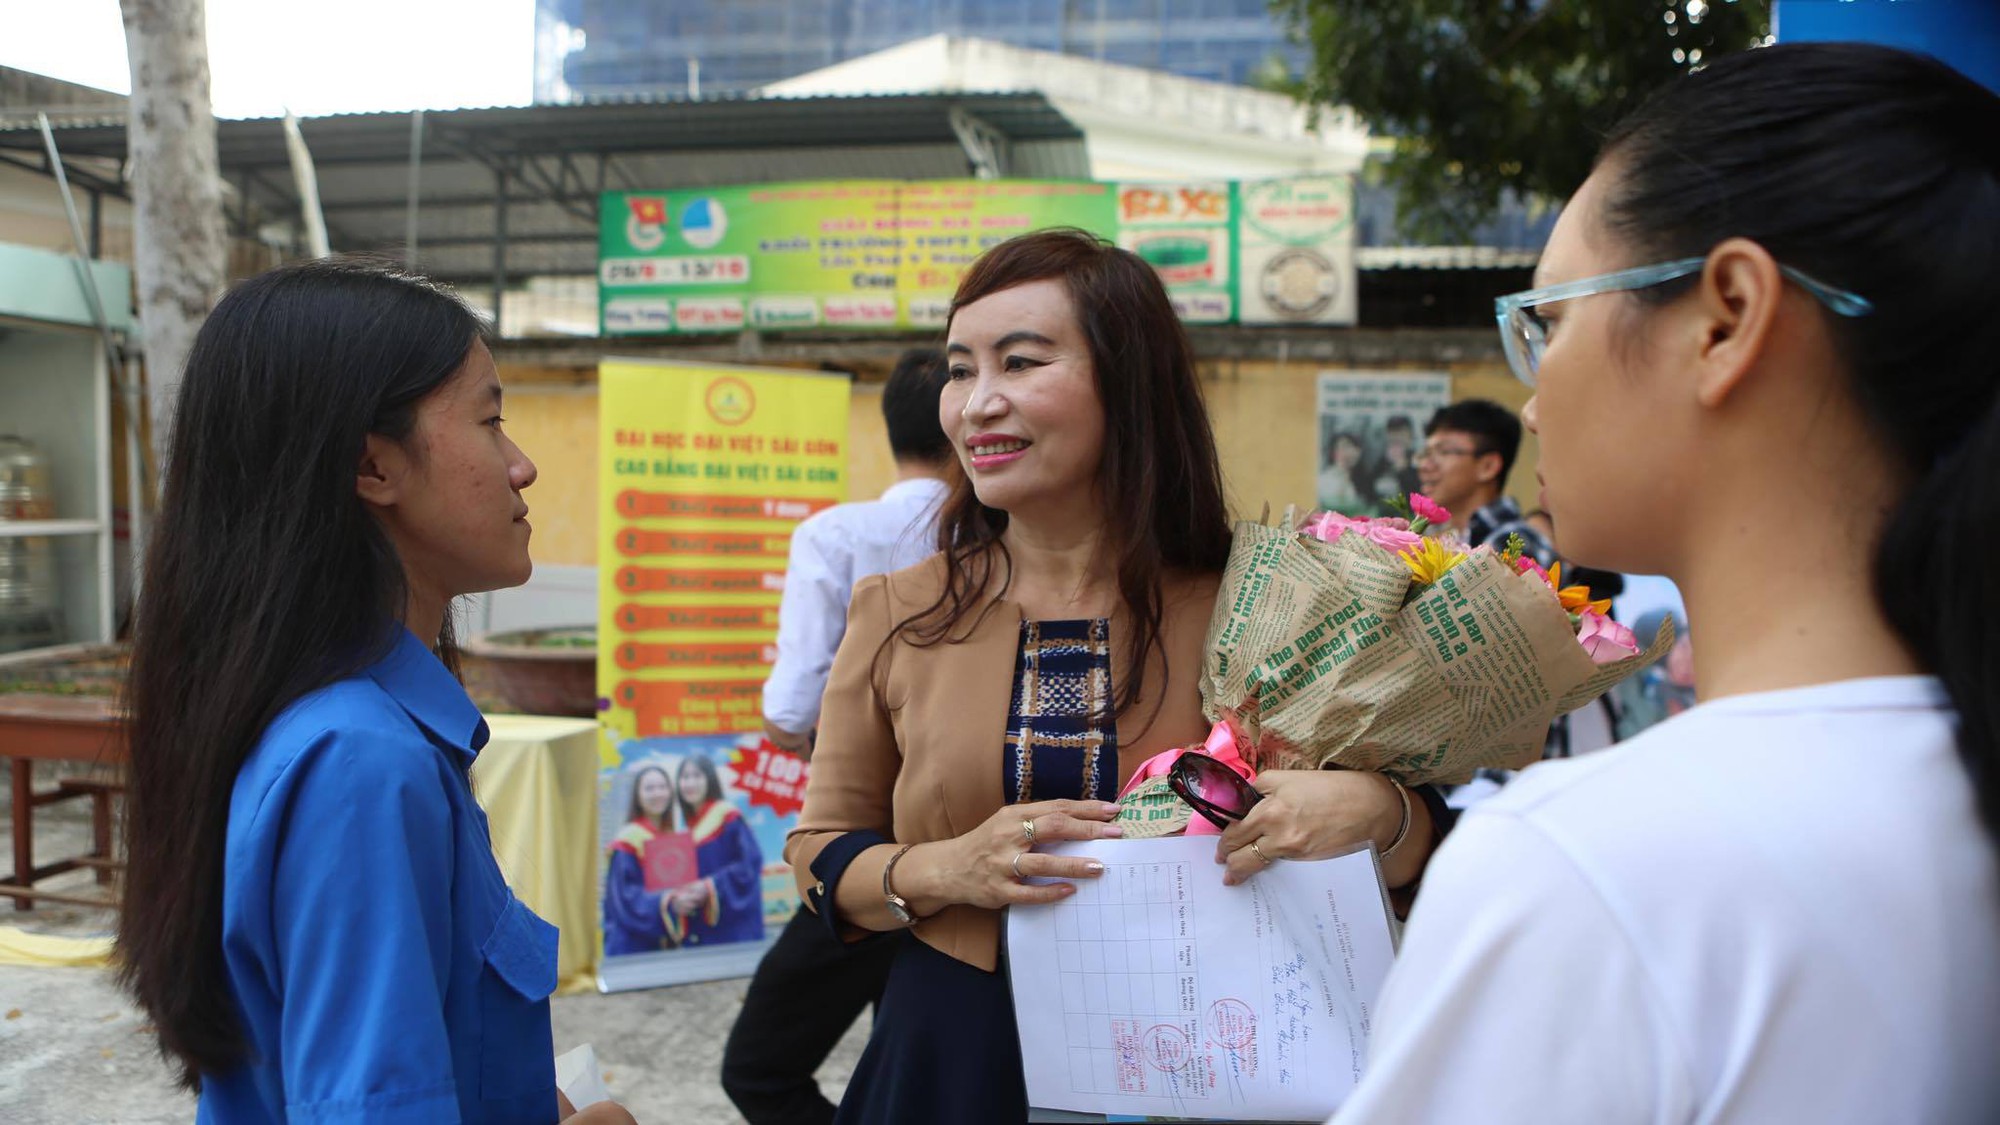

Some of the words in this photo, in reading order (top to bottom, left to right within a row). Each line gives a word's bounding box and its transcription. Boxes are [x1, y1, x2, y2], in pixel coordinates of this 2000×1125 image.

[652, 433, 686, 451] HỌC
[729, 434, 764, 454] VIỆT
[614, 458, 648, 476] CAO
[737, 464, 770, 482] VIỆT
[1265, 644, 1295, 672] the
[1295, 598, 1366, 653] perfect
[1415, 601, 1433, 625] the
[1426, 626, 1454, 663] price
[1429, 594, 1460, 640] than
[1454, 641, 1468, 656] a
[1458, 612, 1486, 646] par
[1279, 661, 1304, 683] be
[1280, 684, 1293, 701] it
[1293, 670, 1316, 692] will
[1316, 661, 1332, 677] be
[1356, 631, 1381, 651] the
